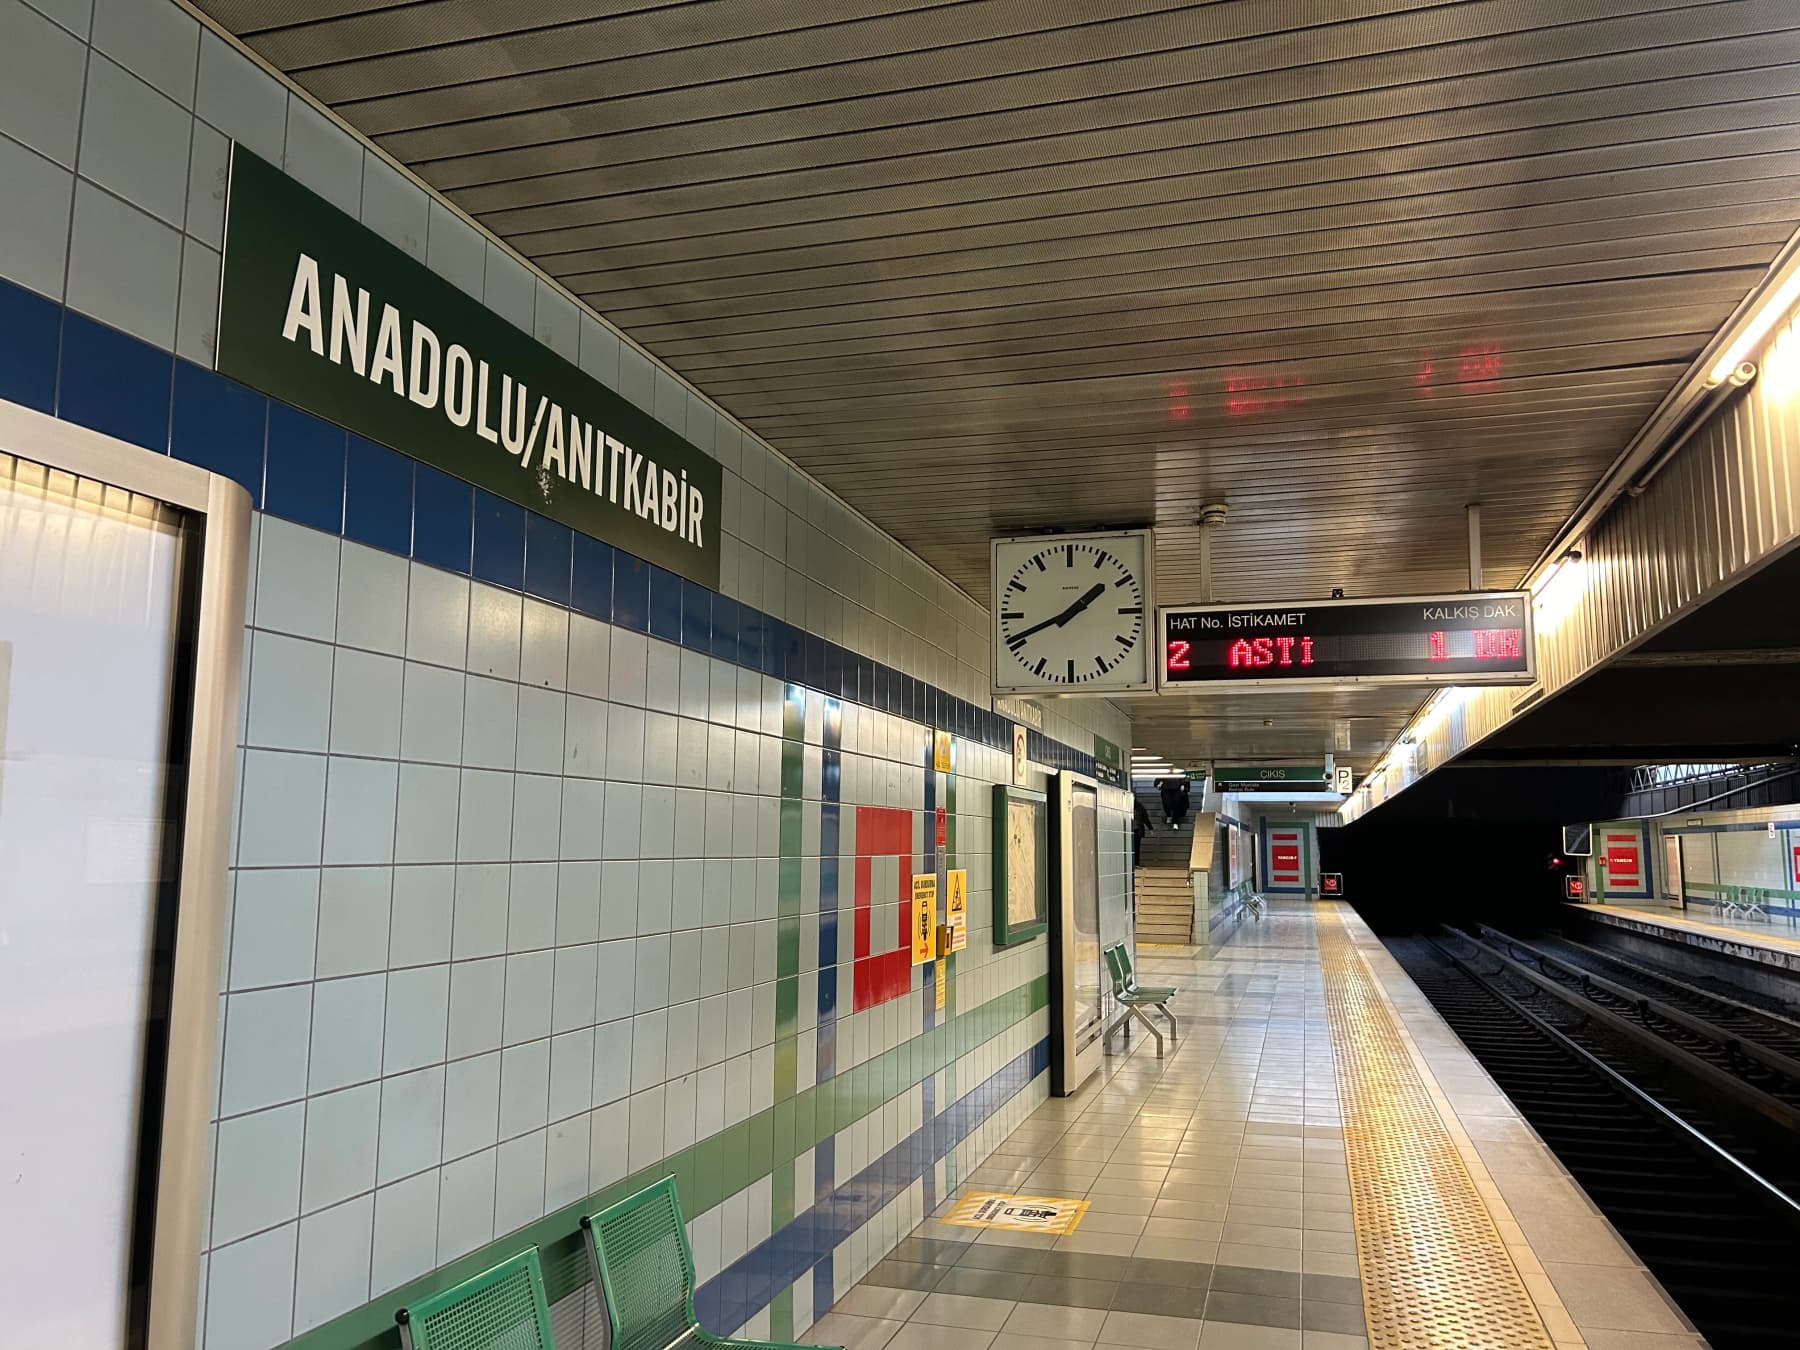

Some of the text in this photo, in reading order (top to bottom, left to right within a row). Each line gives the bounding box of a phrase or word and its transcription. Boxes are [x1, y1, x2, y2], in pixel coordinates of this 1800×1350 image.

[282, 253, 705, 548] ANADOLU/ANITKABİR
[1170, 612, 1307, 629] HAT No. İSTİKAMET
[1423, 604, 1520, 620] KALKIŞ DAK.
[1168, 636, 1314, 668] 2 ASTİ
[1430, 630, 1450, 660] 1
[1338, 770, 1349, 784] P
[1343, 780, 1350, 790] 2
